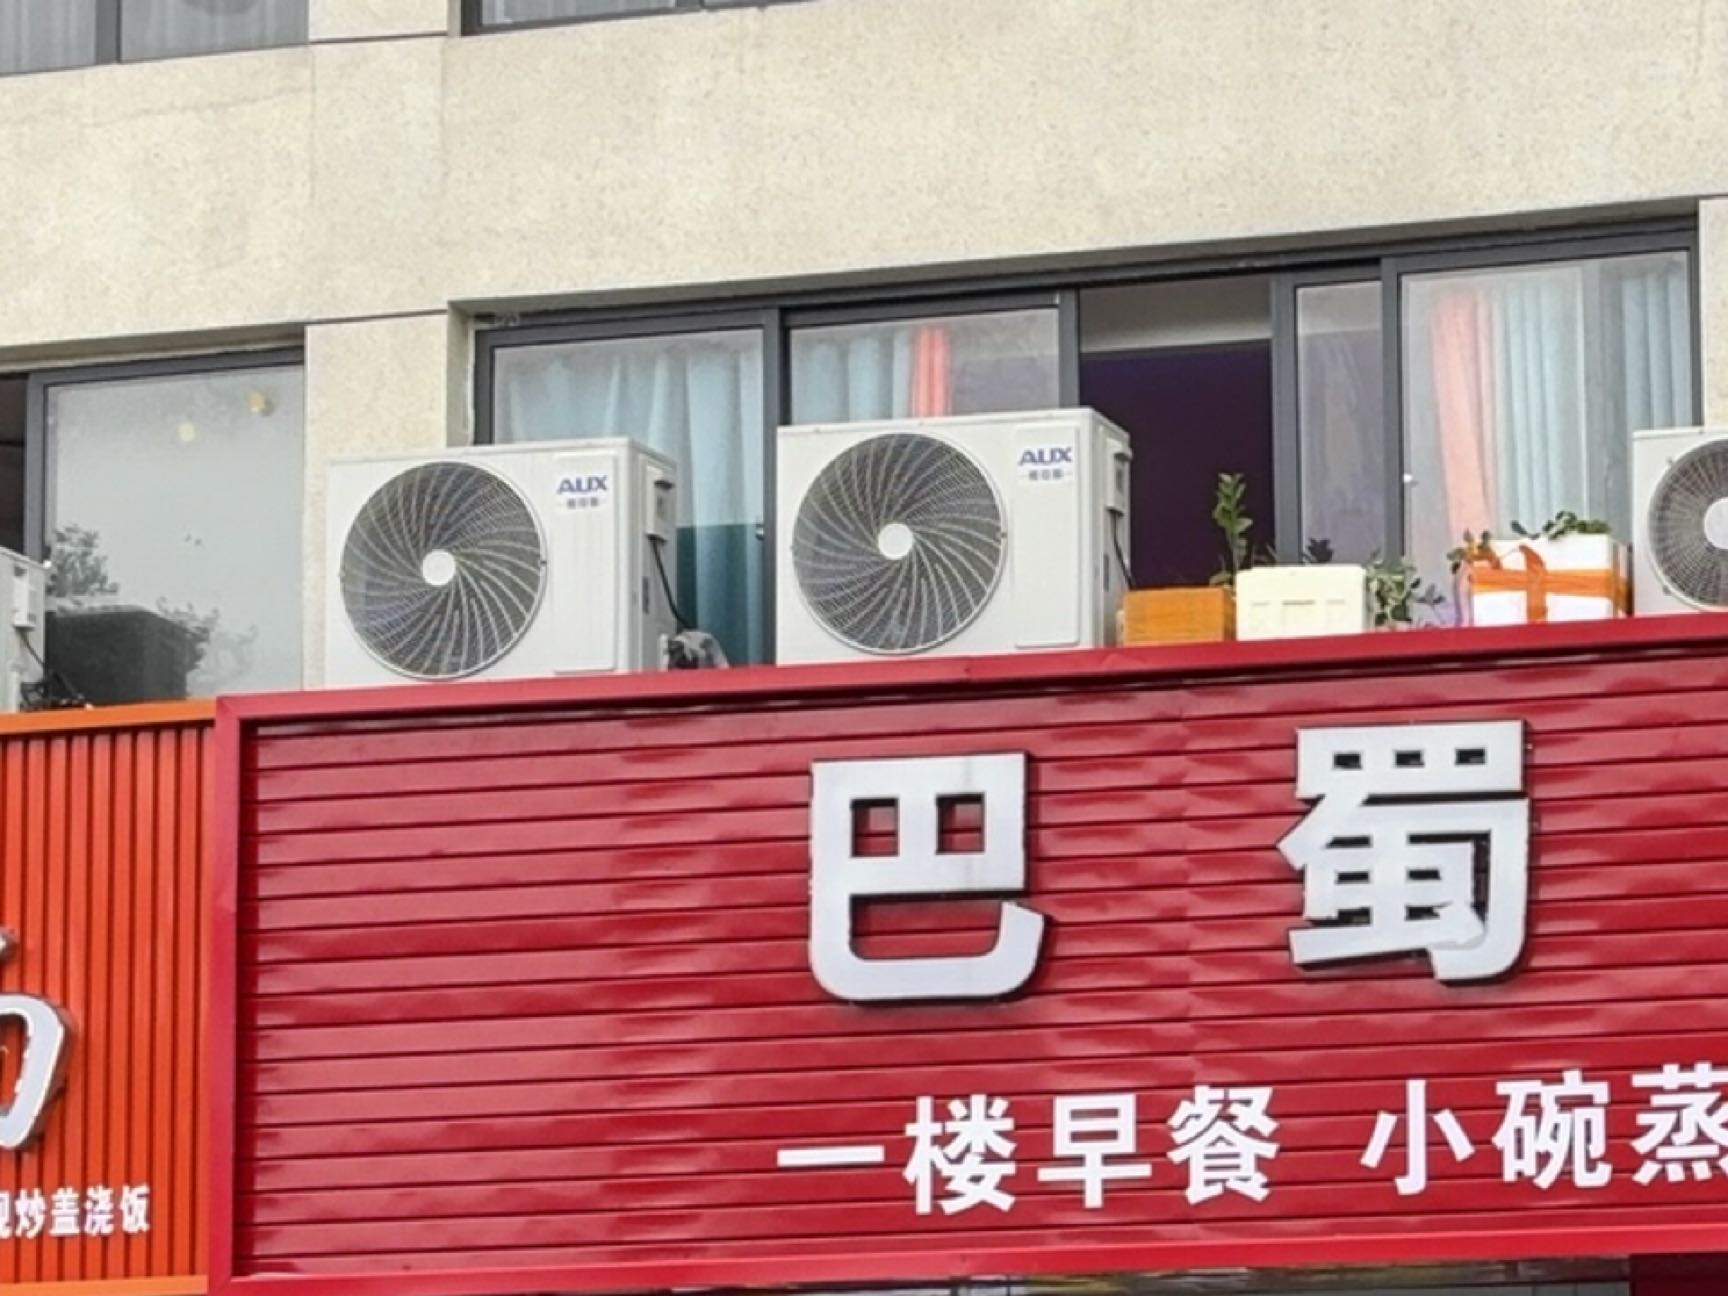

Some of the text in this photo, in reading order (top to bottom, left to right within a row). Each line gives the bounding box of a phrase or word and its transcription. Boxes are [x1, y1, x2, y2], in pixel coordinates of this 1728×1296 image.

[1017, 446, 1072, 466] AUX
[556, 475, 608, 495] AUX
[776, 1083, 1282, 1216] 一楼早餐
